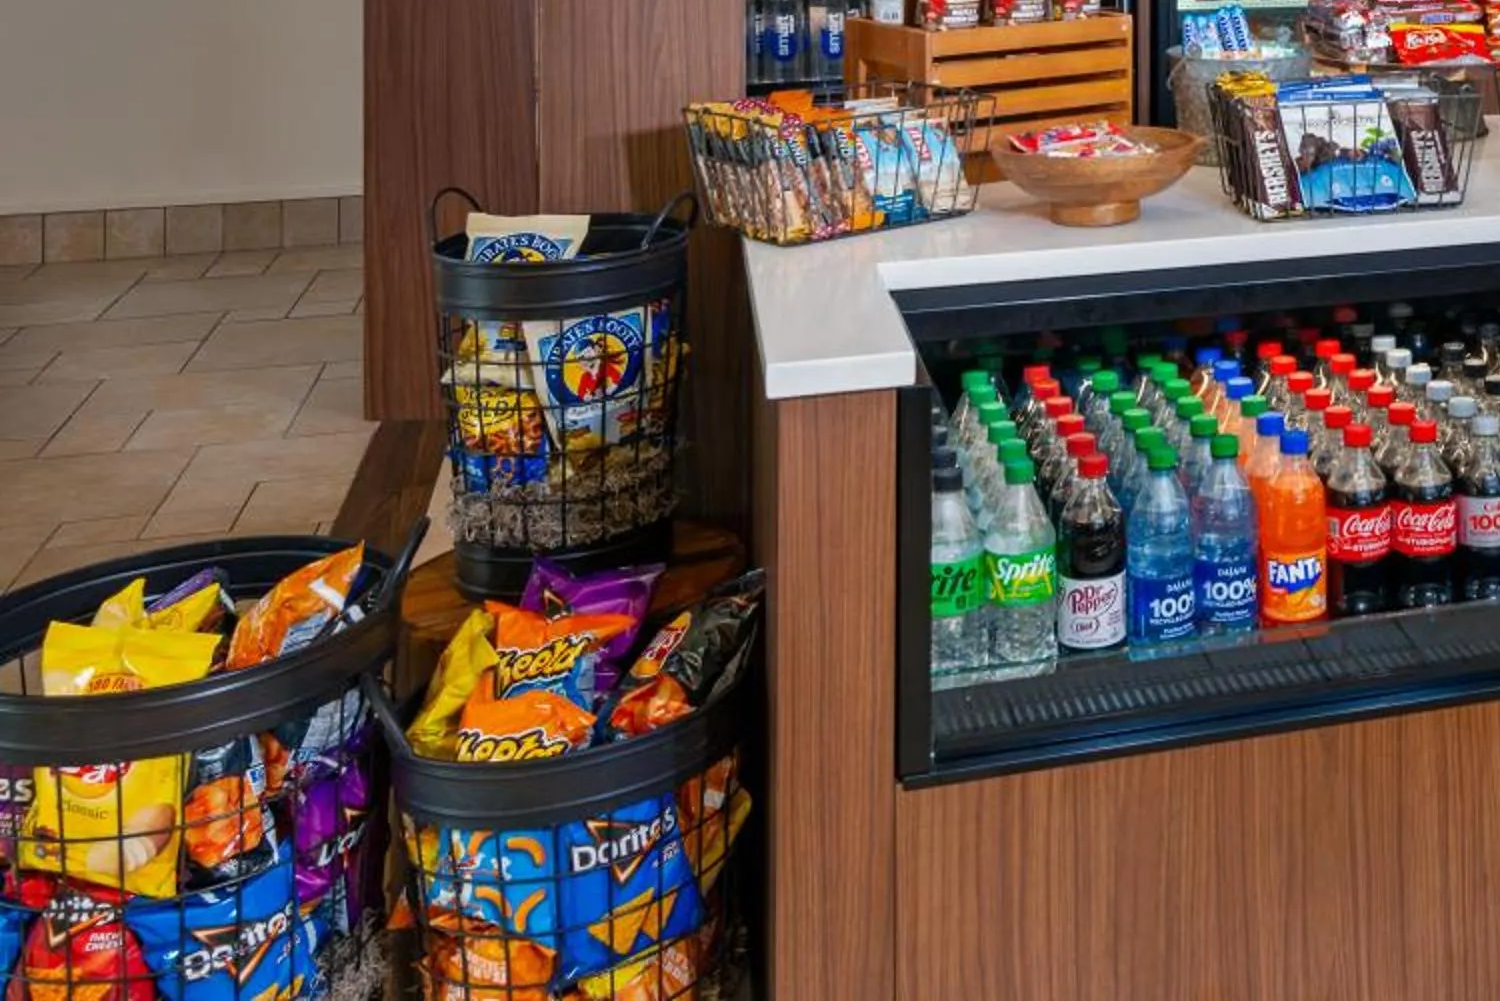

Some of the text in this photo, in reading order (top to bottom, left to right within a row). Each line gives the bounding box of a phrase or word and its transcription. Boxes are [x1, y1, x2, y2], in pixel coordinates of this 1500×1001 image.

[1254, 129, 1289, 204] HERSHEY'S
[931, 565, 977, 596] rite
[997, 553, 1056, 586] Sprite
[497, 632, 588, 693] heetos
[571, 806, 677, 874] Doritos
[183, 900, 294, 981] Doitos
